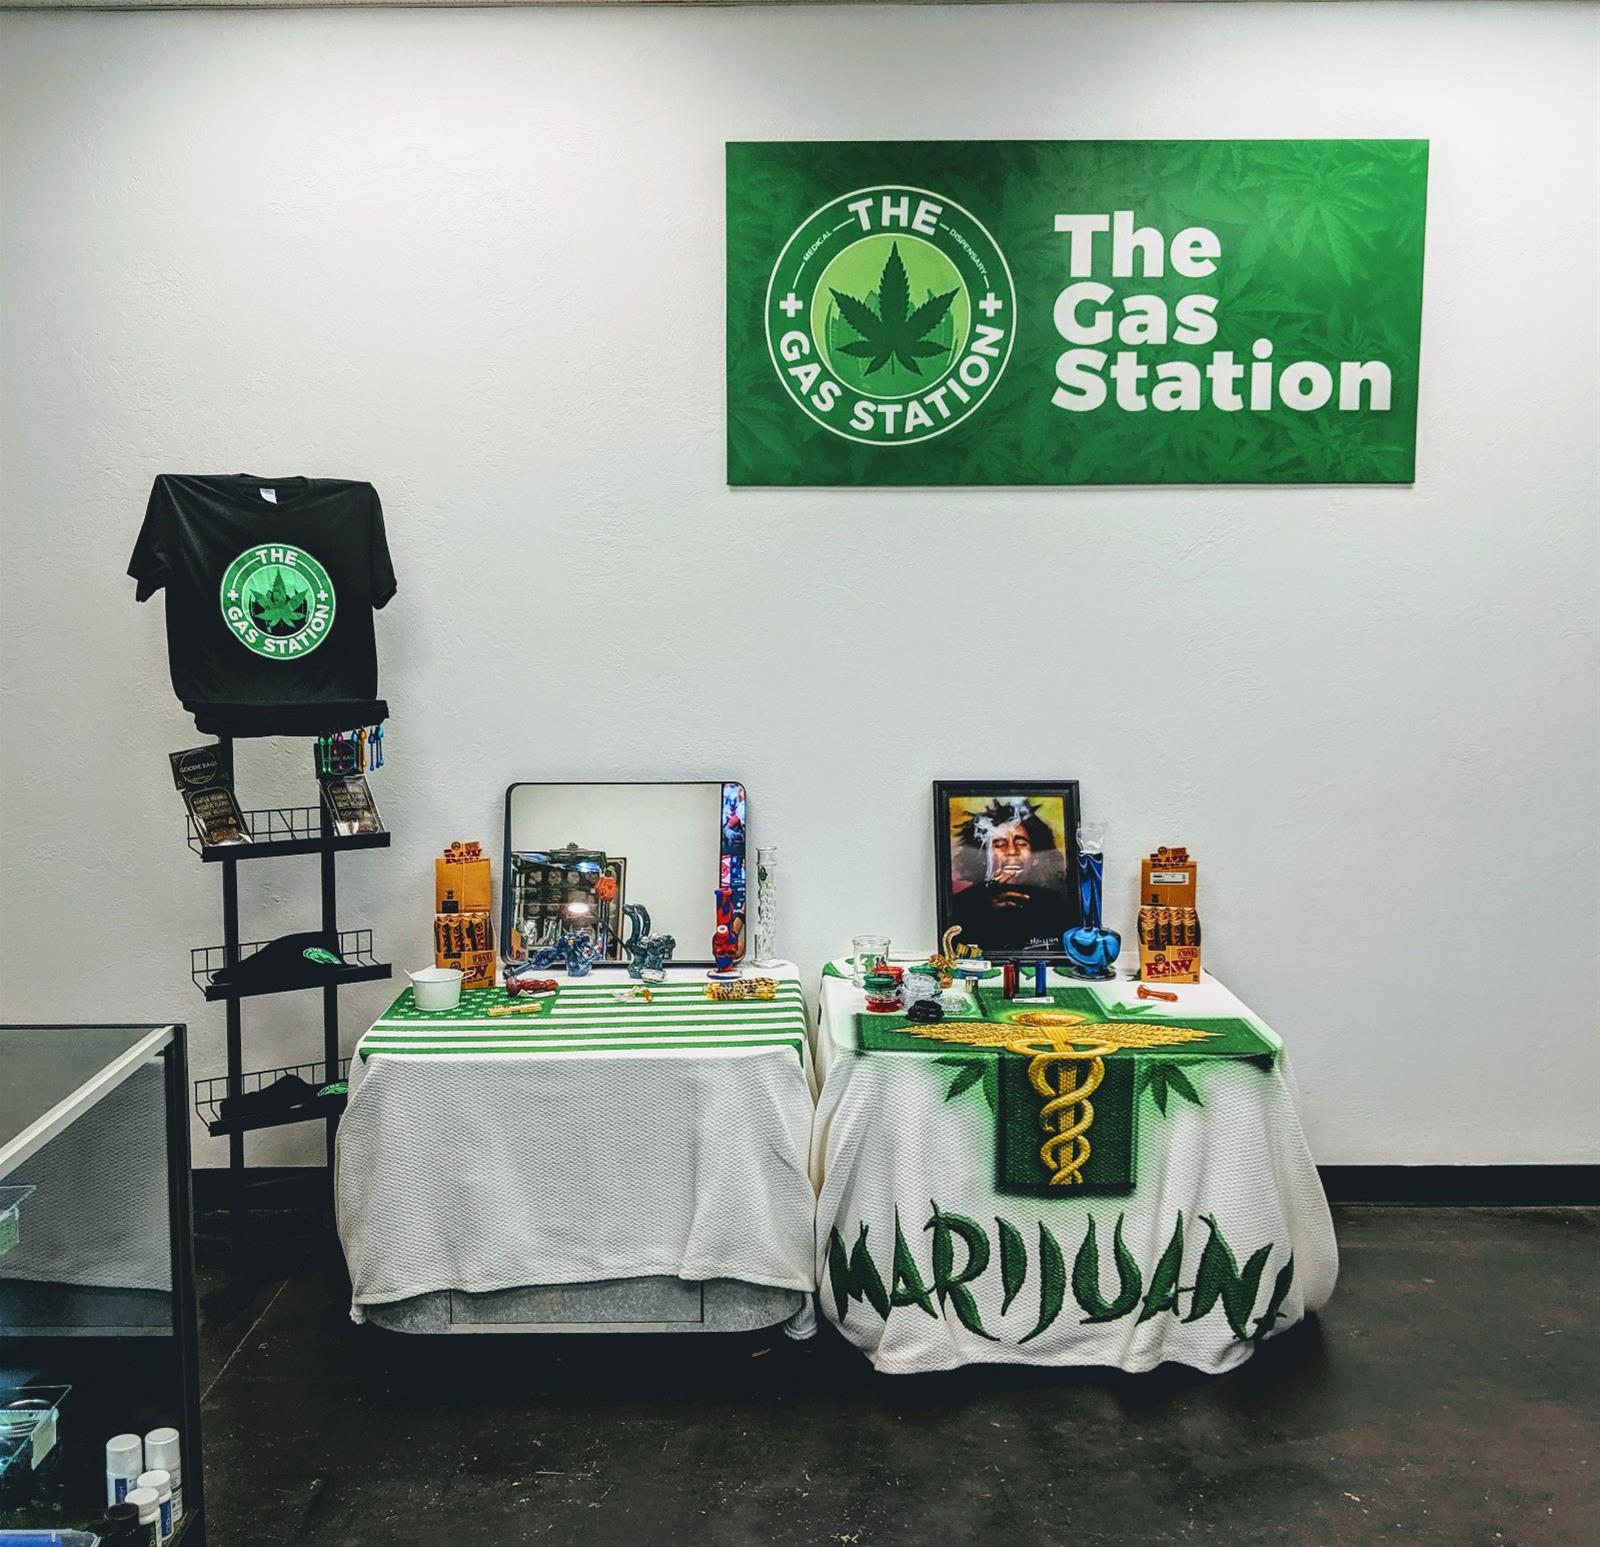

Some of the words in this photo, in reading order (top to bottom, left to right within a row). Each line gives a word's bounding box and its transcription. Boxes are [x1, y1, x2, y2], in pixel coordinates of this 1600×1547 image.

[847, 196, 943, 235] THE
[803, 229, 833, 262] MEDICAL
[949, 228, 988, 274] DISPENSARY
[1054, 211, 1221, 278] The
[1053, 281, 1219, 346] Gas
[779, 330, 842, 412] GAS
[849, 324, 1005, 434] STATION
[1051, 339, 1392, 413] Station
[256, 548, 298, 567] THE
[227, 606, 259, 643] GAS
[262, 604, 330, 654] STATION
[1145, 959, 1193, 976] RAW
